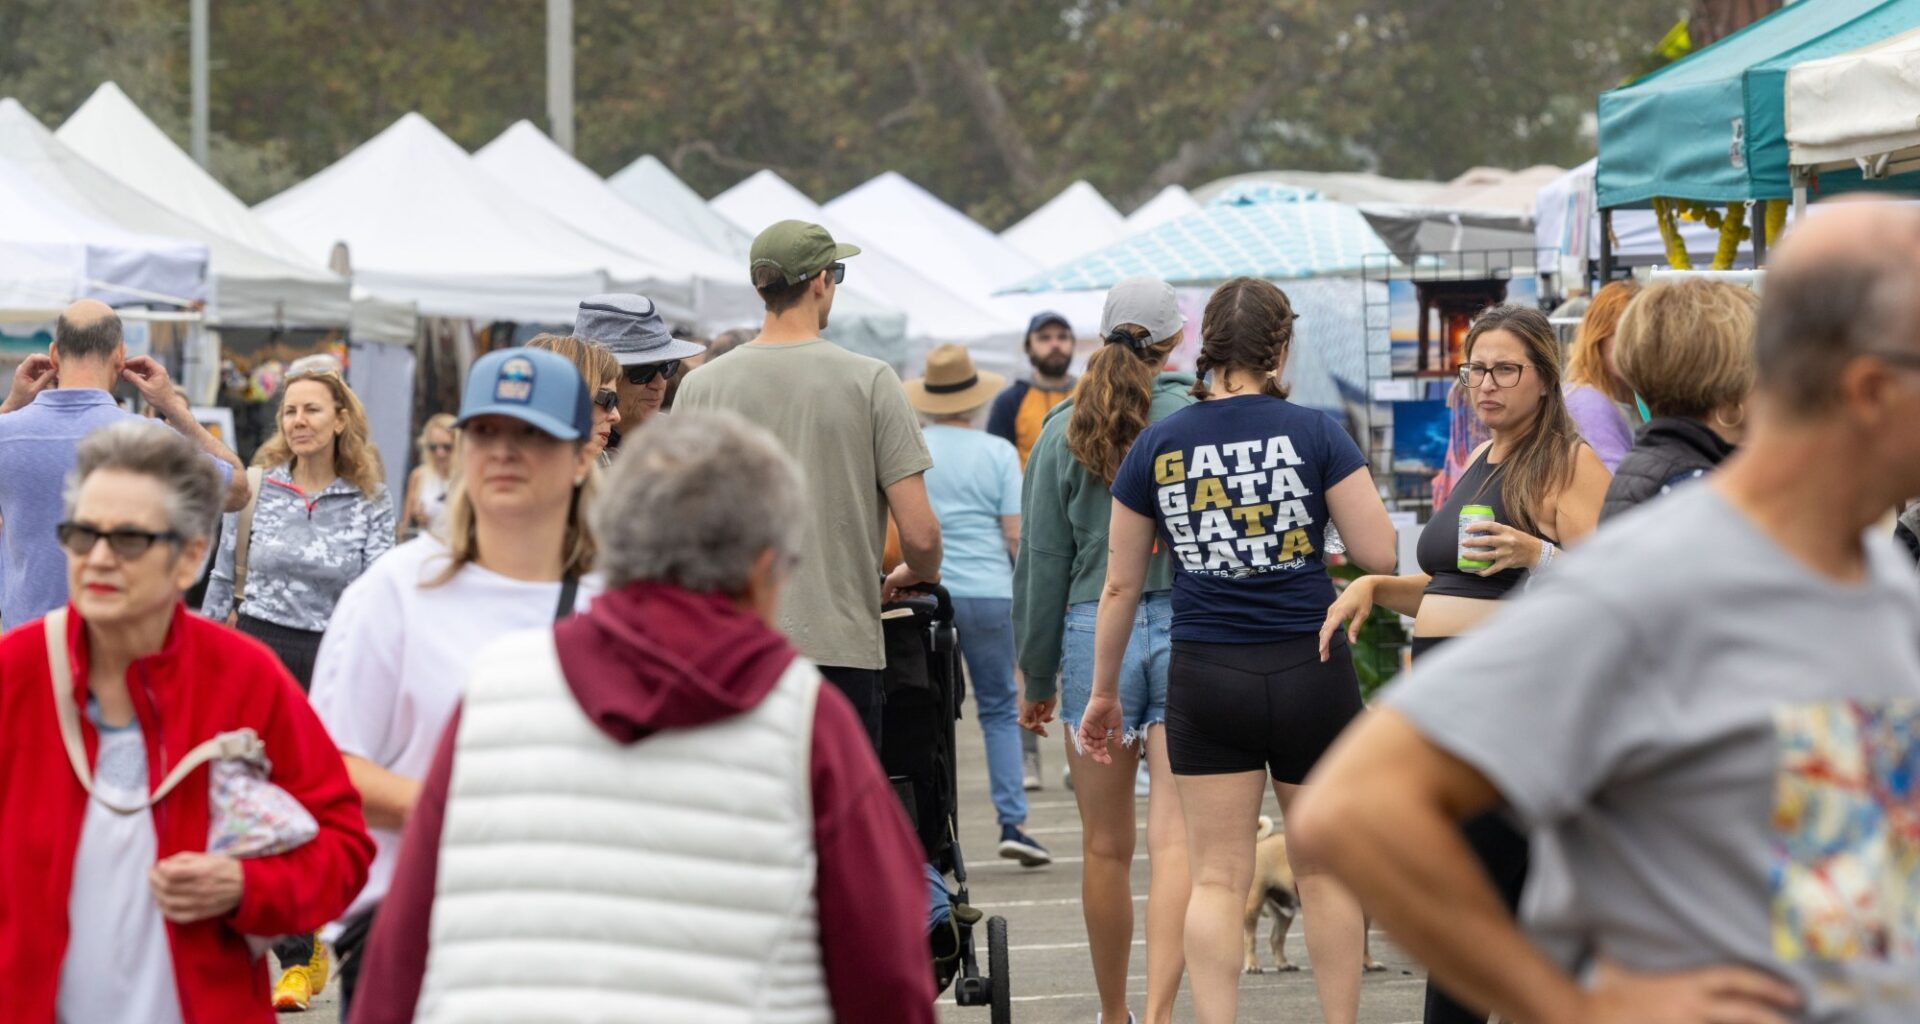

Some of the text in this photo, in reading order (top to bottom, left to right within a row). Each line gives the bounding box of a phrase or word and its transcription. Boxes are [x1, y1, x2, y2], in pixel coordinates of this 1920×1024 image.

[1154, 435, 1302, 485] GATA
[1157, 467, 1309, 516] GATA
[1164, 499, 1313, 544] GATA
[1174, 528, 1315, 570] GATA
